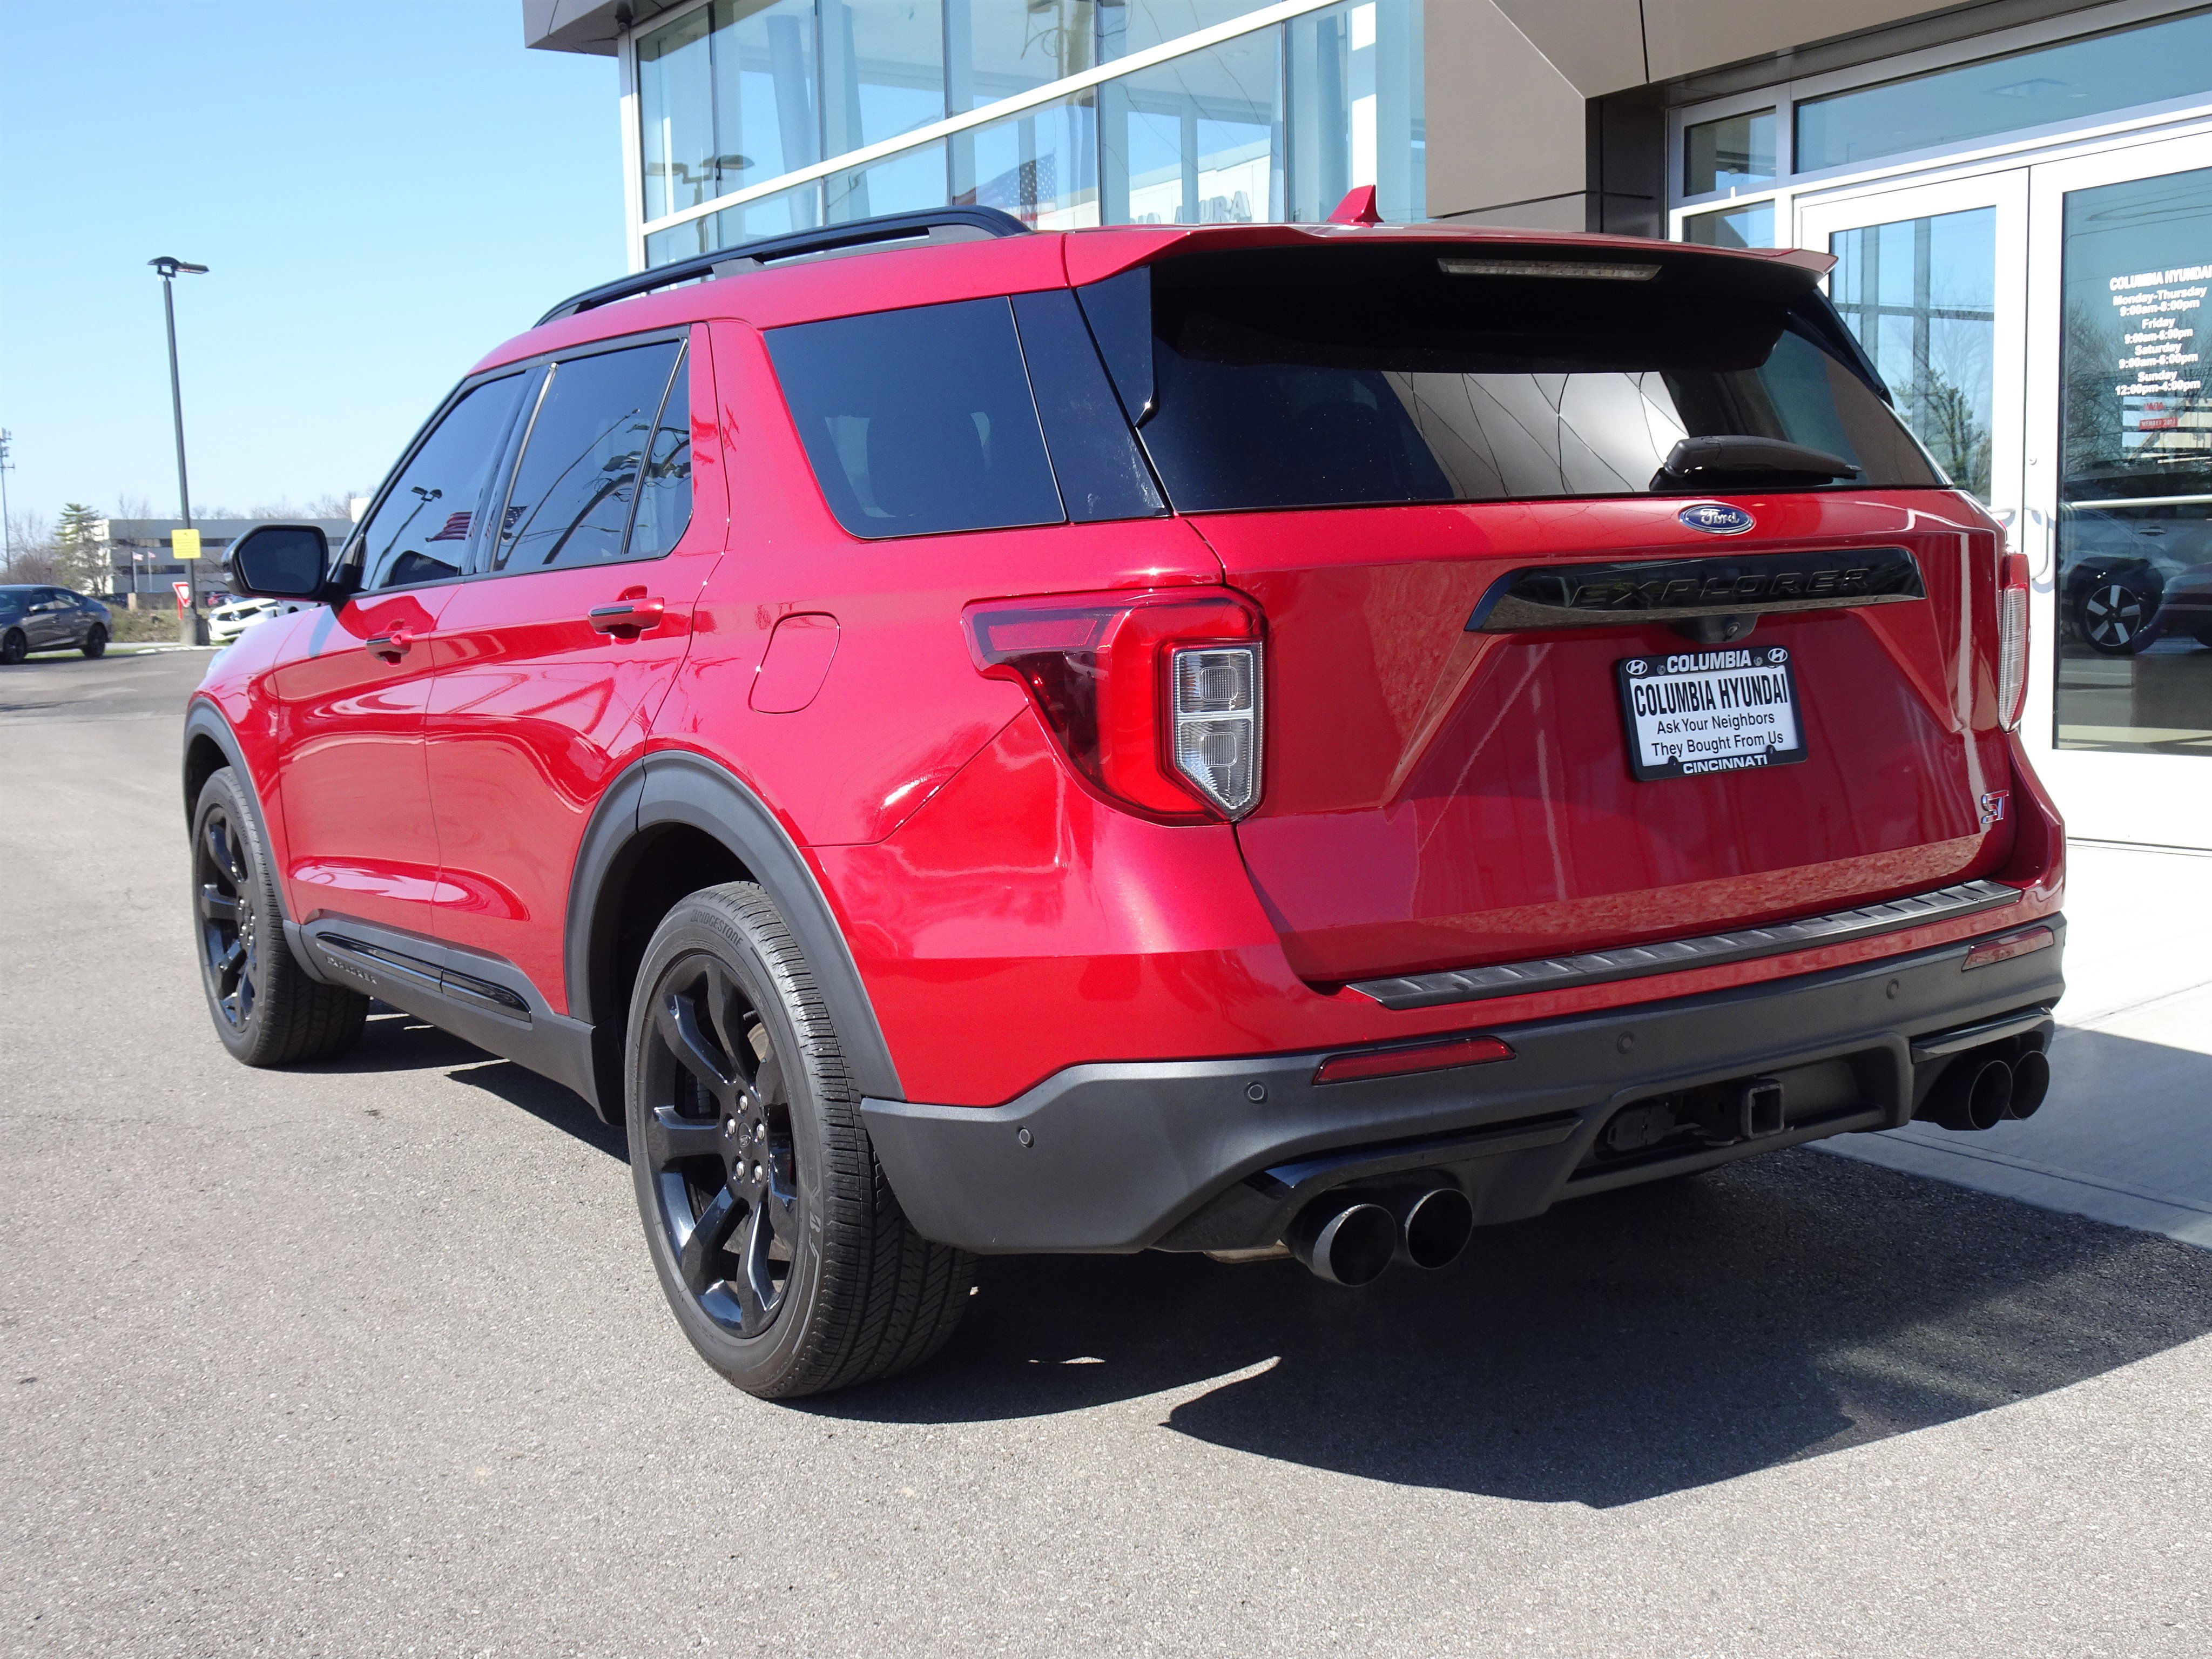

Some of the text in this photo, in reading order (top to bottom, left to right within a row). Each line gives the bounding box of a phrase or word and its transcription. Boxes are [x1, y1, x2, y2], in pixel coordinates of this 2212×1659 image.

[1174, 191, 1252, 224] AURA
[2109, 272, 2163, 291] COLUMBIA
[2113, 286, 2207, 306] Monday-Thursday
[2142, 317, 2175, 329] Friday
[2124, 328, 2193, 344] 9:00am-6:00pm
[2135, 342, 2182, 355] Saturday
[2119, 353, 2198, 369] 9:00am-6:00pm
[2137, 370, 2177, 382] Sunday
[2115, 380, 2201, 395] 12:00pm-4:00pm
[1700, 508, 1740, 525] Ford
[1568, 568, 1870, 609] EXPLORER
[1667, 650, 1752, 673] COLUMBIA
[1634, 673, 1789, 717] COLUMBIA HYUNDAI
[1657, 712, 1775, 735] Ask Your Neighbors
[1651, 731, 1784, 758] They Bought From Us
[1683, 754, 1768, 774] CINCINNATI
[1980, 789, 2009, 824] ST
[690, 908, 744, 948] BRIDGESTONE
